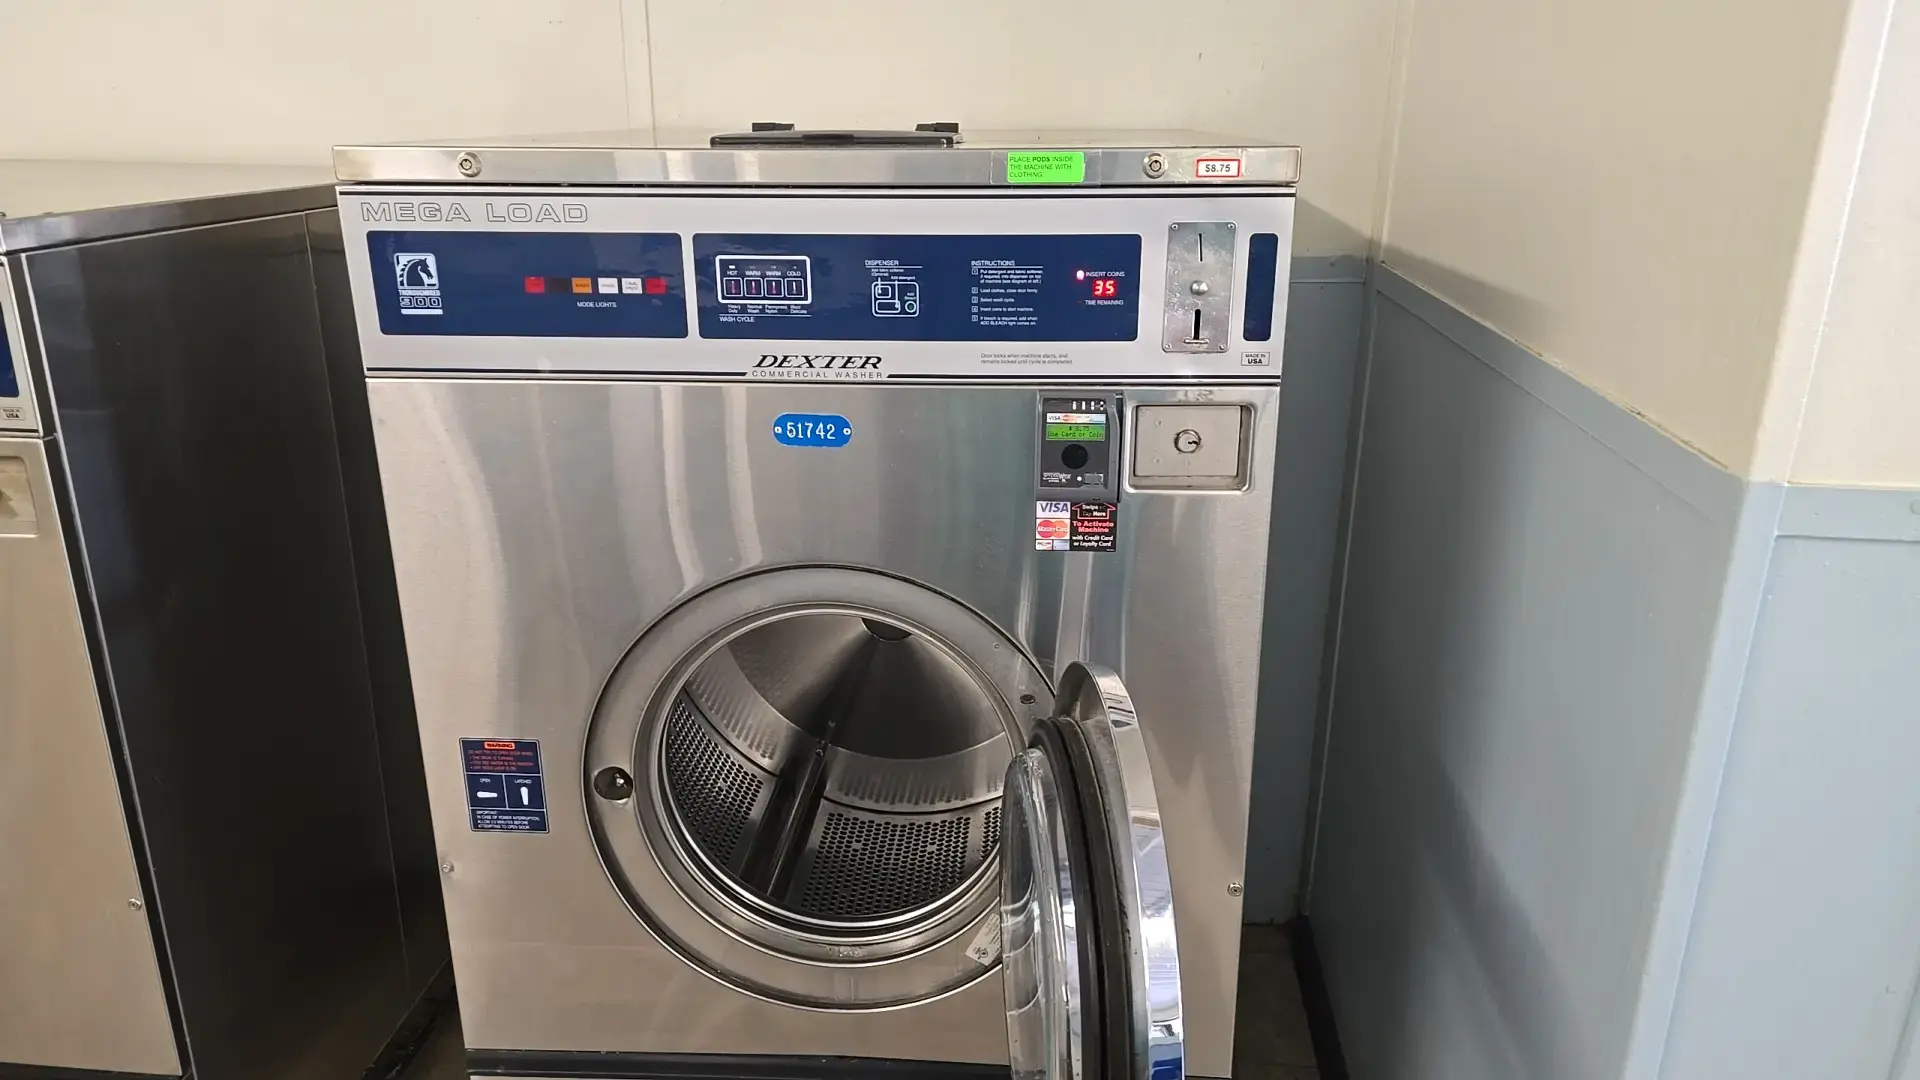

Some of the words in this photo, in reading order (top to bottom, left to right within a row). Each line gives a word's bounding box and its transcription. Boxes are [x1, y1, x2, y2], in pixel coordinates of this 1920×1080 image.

[360, 202, 472, 223] MEGA
[485, 202, 588, 223] LOAD
[1093, 280, 1115, 295] 35
[752, 354, 883, 369] DEXTER
[751, 370, 829, 379] COMMERCIAL
[834, 370, 883, 379] WASHER
[786, 421, 836, 440] 51742
[1040, 502, 1069, 513] VISA
